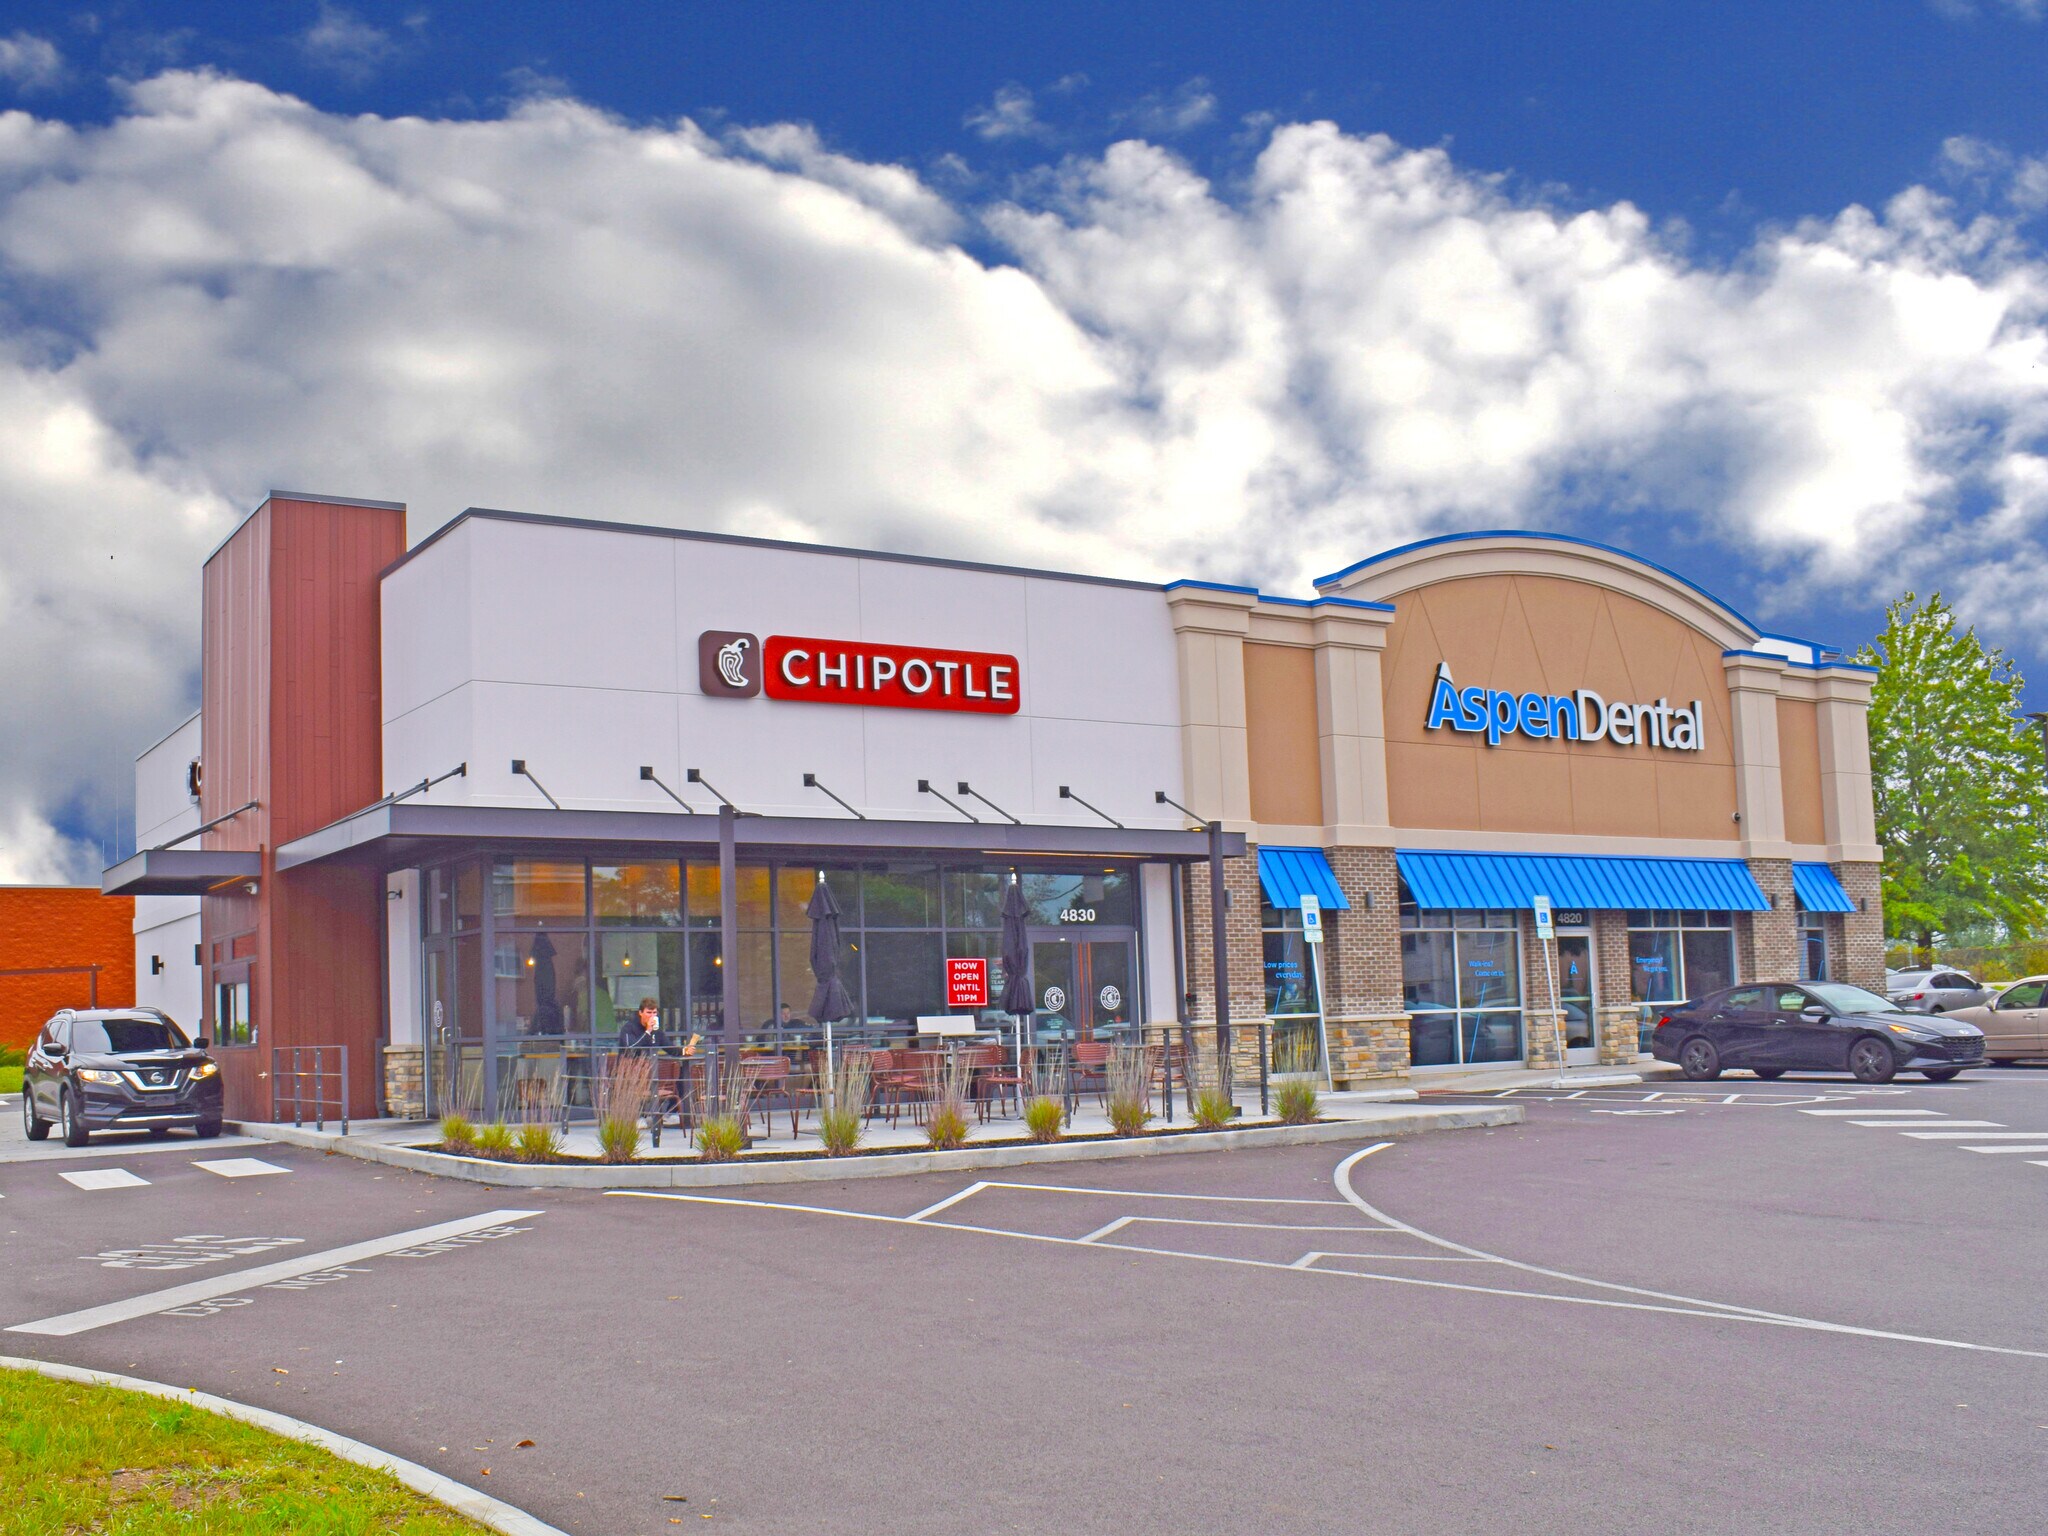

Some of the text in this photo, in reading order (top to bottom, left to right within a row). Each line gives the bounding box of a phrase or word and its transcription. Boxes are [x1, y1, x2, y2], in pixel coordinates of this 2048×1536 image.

[781, 649, 1013, 700] CHIPOTLE
[1060, 908, 1096, 922] 4830
[1557, 913, 1582, 924] 4820
[954, 962, 978, 970] NOW
[1263, 961, 1298, 970] Low prices
[953, 972, 979, 981] OPEN
[952, 983, 981, 992] UNTIL
[956, 994, 978, 1002] 11PM
[77, 1235, 305, 1270] STOP
[159, 1226, 534, 1317] DO NOT ENTER
